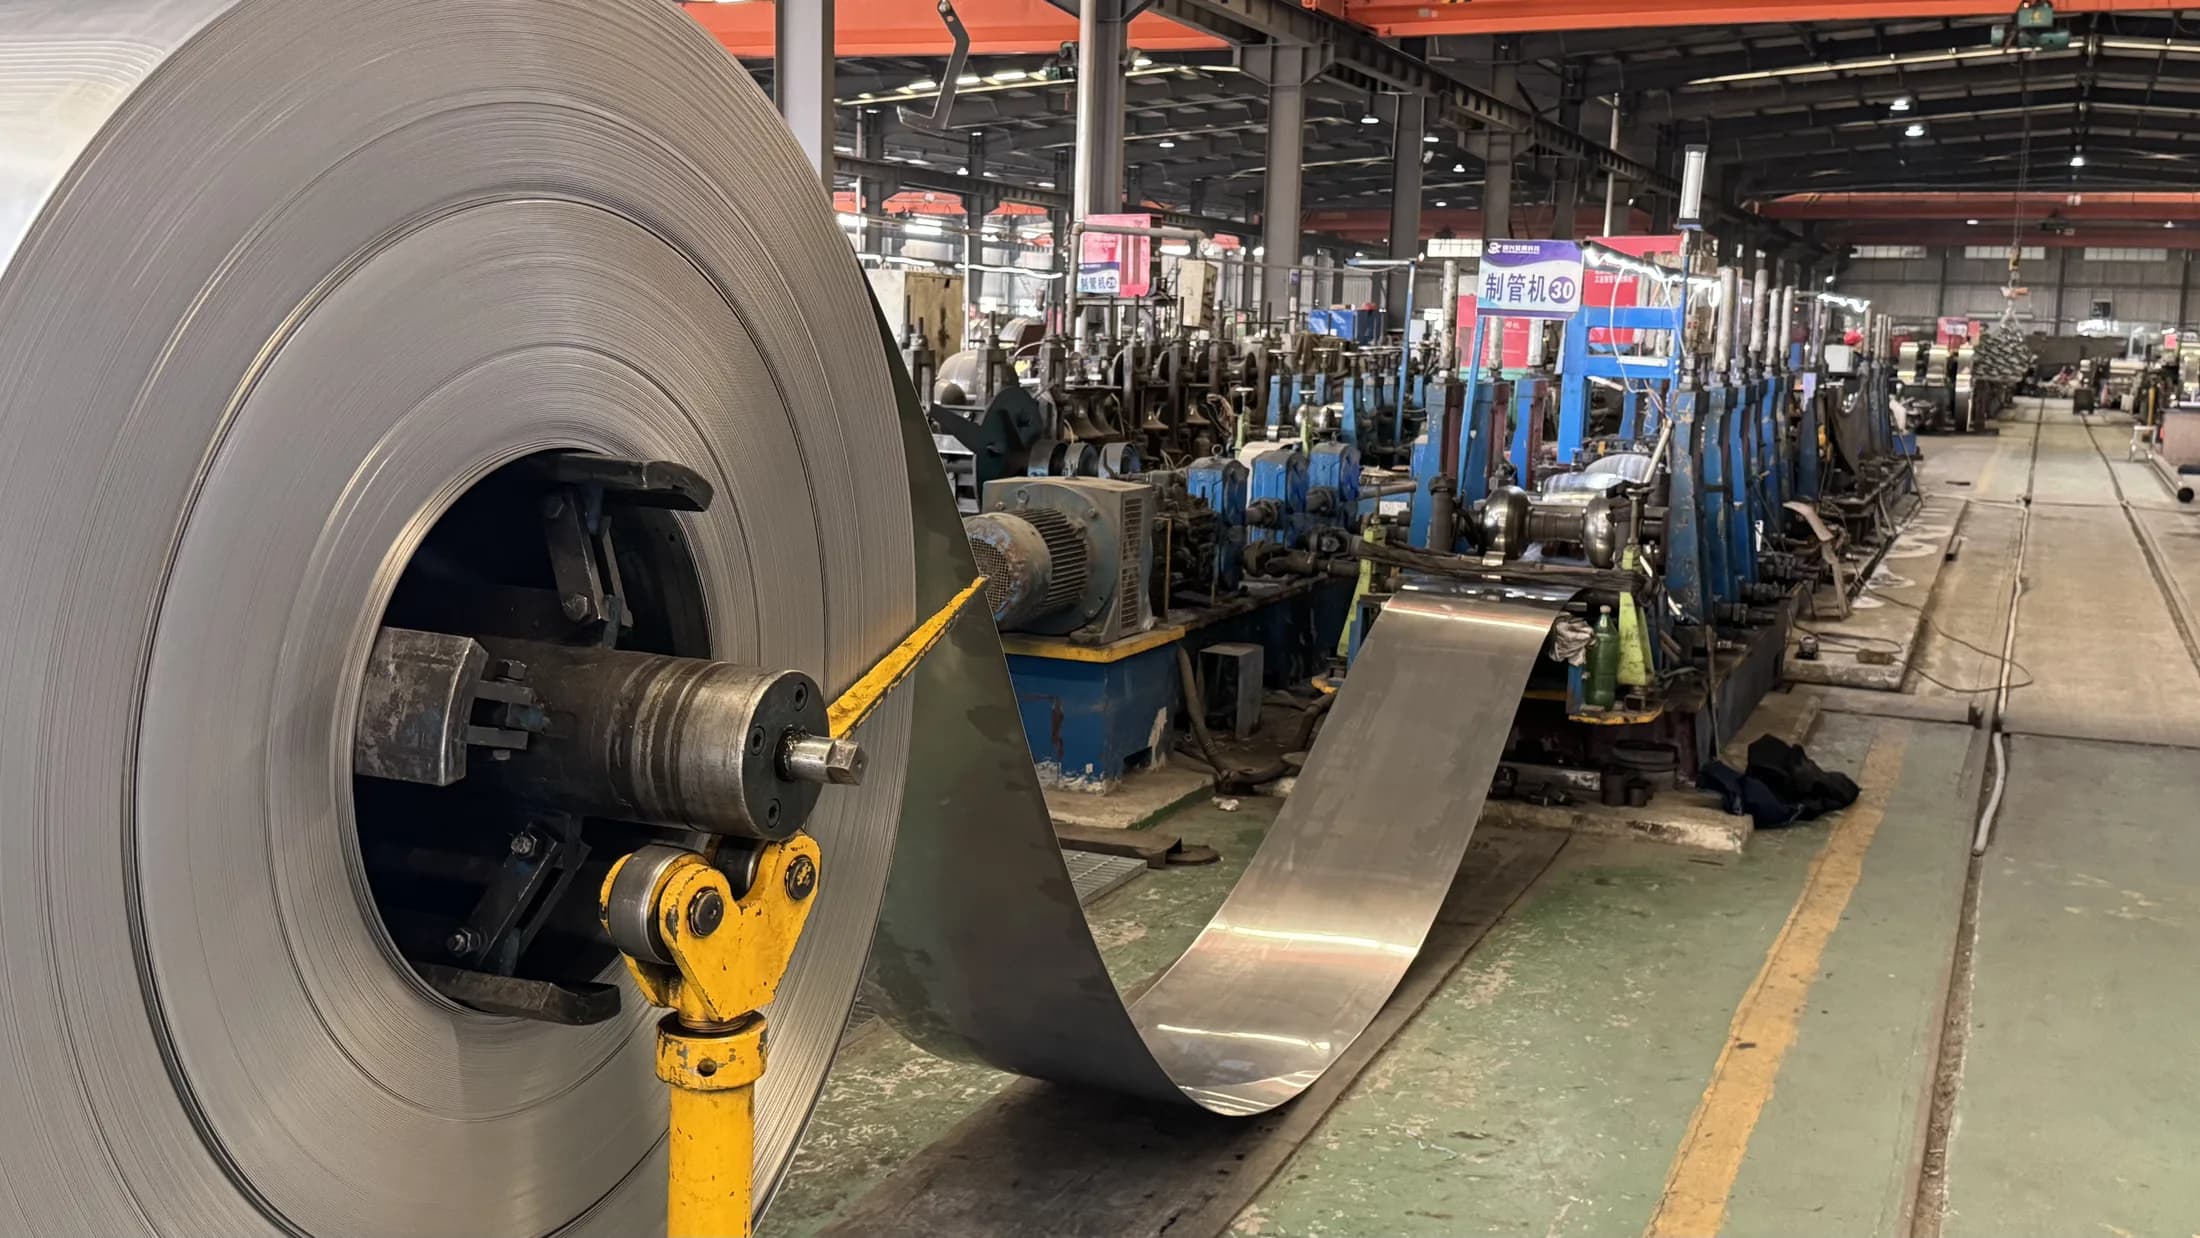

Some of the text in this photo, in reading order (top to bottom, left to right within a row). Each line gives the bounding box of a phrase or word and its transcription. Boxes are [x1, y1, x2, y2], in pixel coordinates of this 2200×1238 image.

[1485, 272, 1575, 303] 制管机 30
